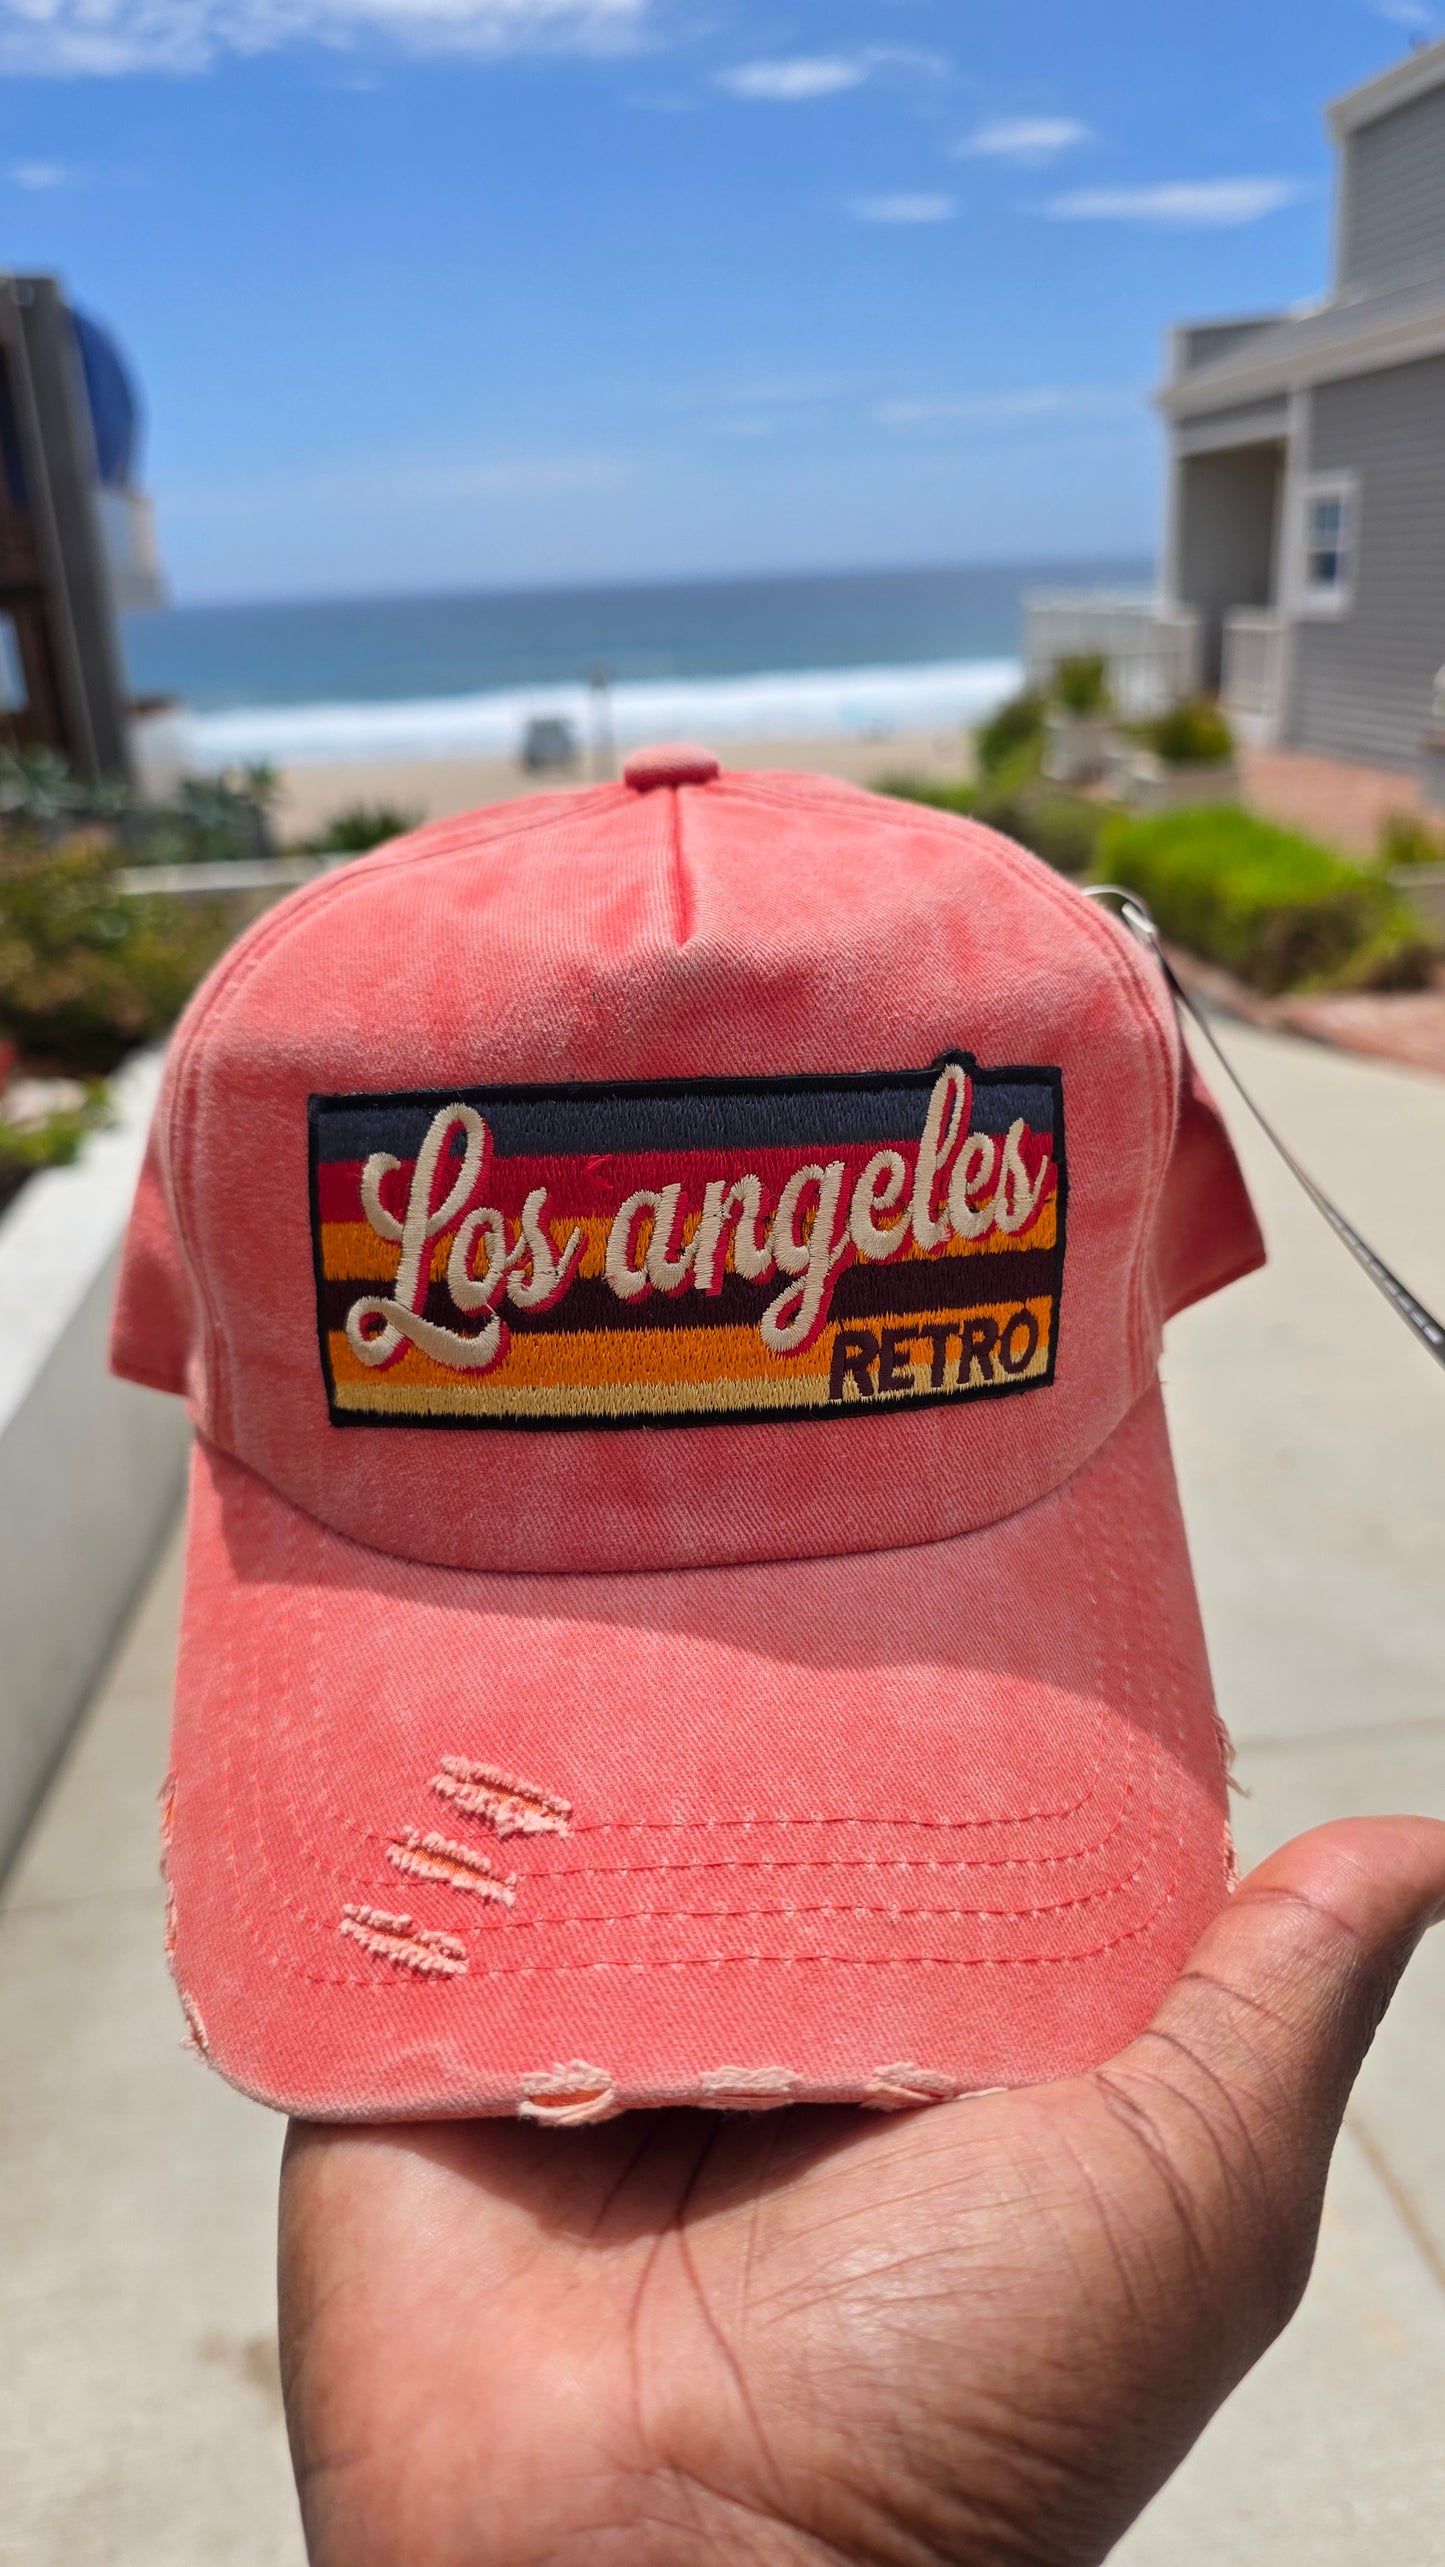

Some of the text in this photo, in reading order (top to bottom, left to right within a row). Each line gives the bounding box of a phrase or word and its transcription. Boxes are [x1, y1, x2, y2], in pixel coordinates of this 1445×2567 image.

[345, 1063, 1050, 1372] Los angeles
[829, 1309, 1038, 1400] RETRO
